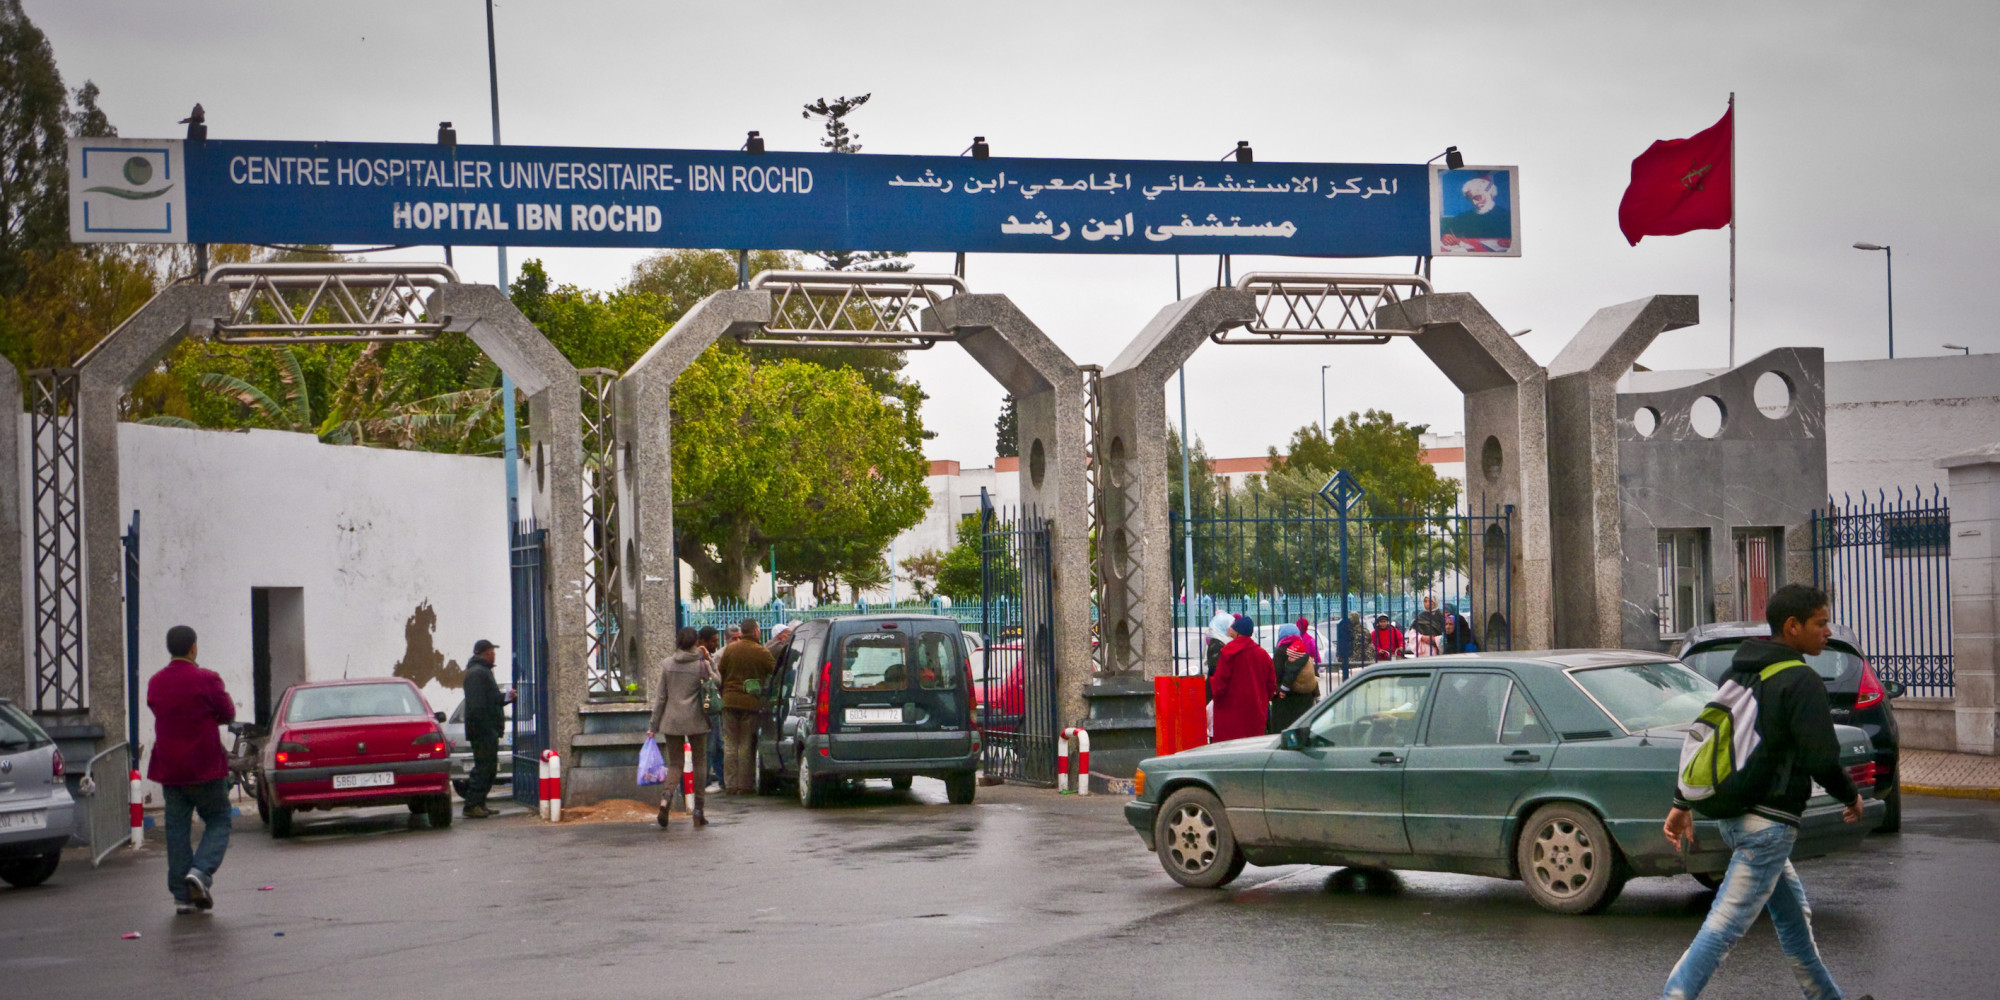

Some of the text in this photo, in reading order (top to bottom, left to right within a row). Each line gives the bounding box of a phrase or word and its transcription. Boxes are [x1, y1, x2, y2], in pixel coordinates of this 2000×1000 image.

[230, 156, 814, 194] CENTRE HOSPITALIER UNIVERSITAIRE- IBN ROCHD
[888, 168, 954, 194] رشد
[1142, 173, 1319, 201] الاستشفائي
[1325, 176, 1398, 200] المركز
[393, 201, 662, 233] HOPITAL IBN ROCHD
[1000, 210, 1298, 242] مستشفى ابن رشد
